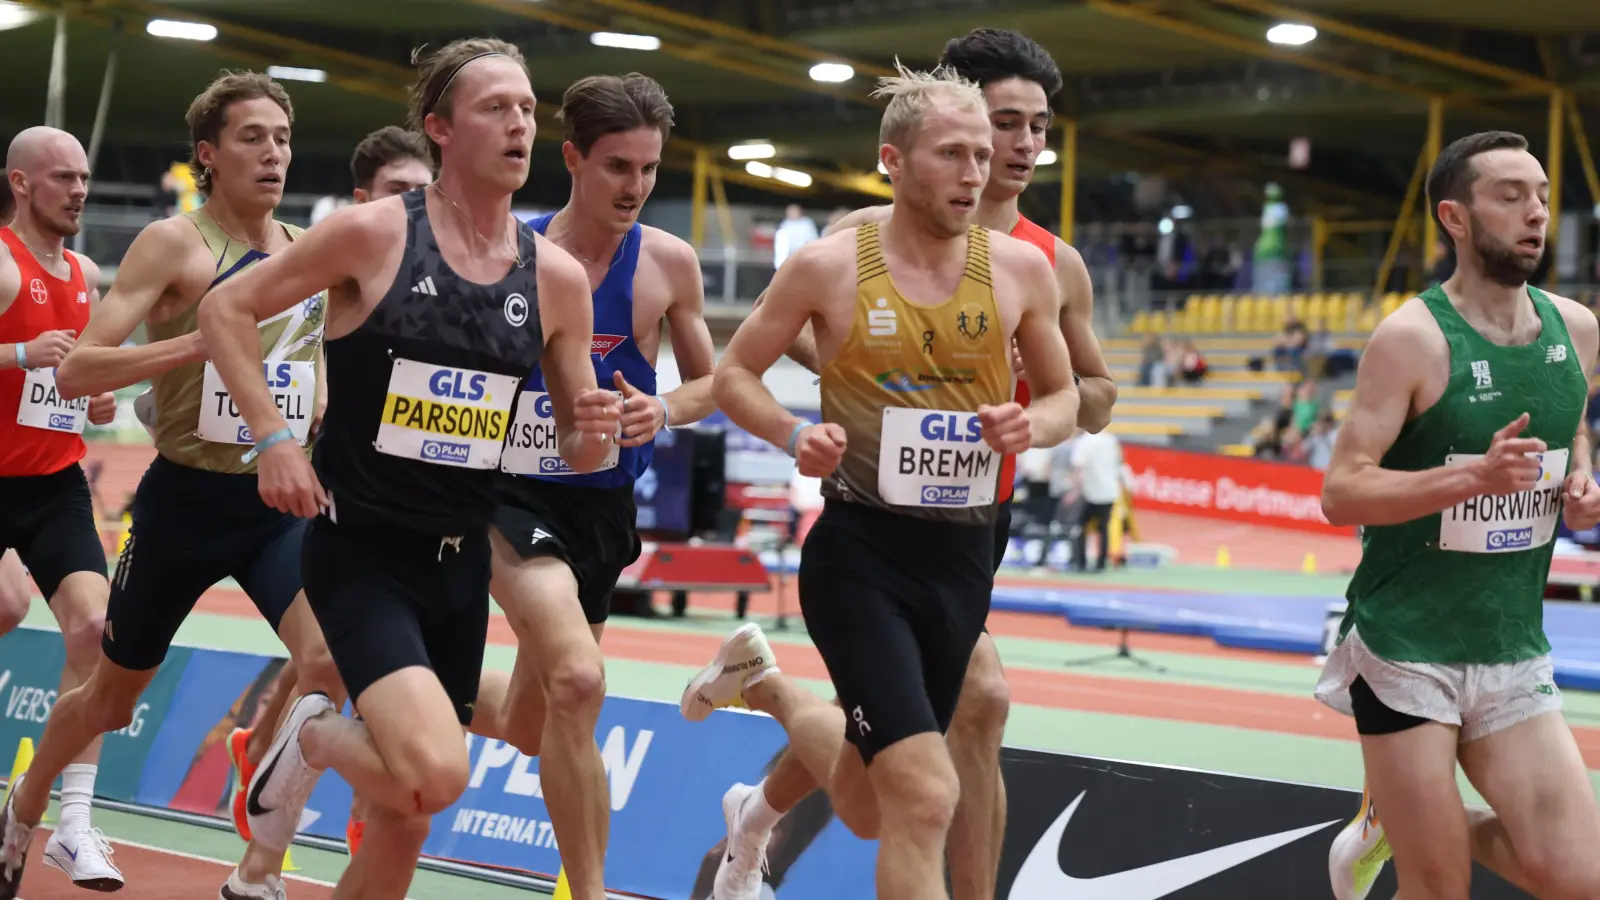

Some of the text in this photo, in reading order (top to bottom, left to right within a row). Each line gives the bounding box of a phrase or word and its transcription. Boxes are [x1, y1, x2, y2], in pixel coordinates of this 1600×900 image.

[391, 396, 502, 439] PARSONS
[441, 446, 468, 457] PLAN
[898, 446, 993, 478] BREMM
[942, 489, 968, 498] PLAN
[1506, 530, 1531, 540] PLAN
[468, 725, 654, 811] PLN
